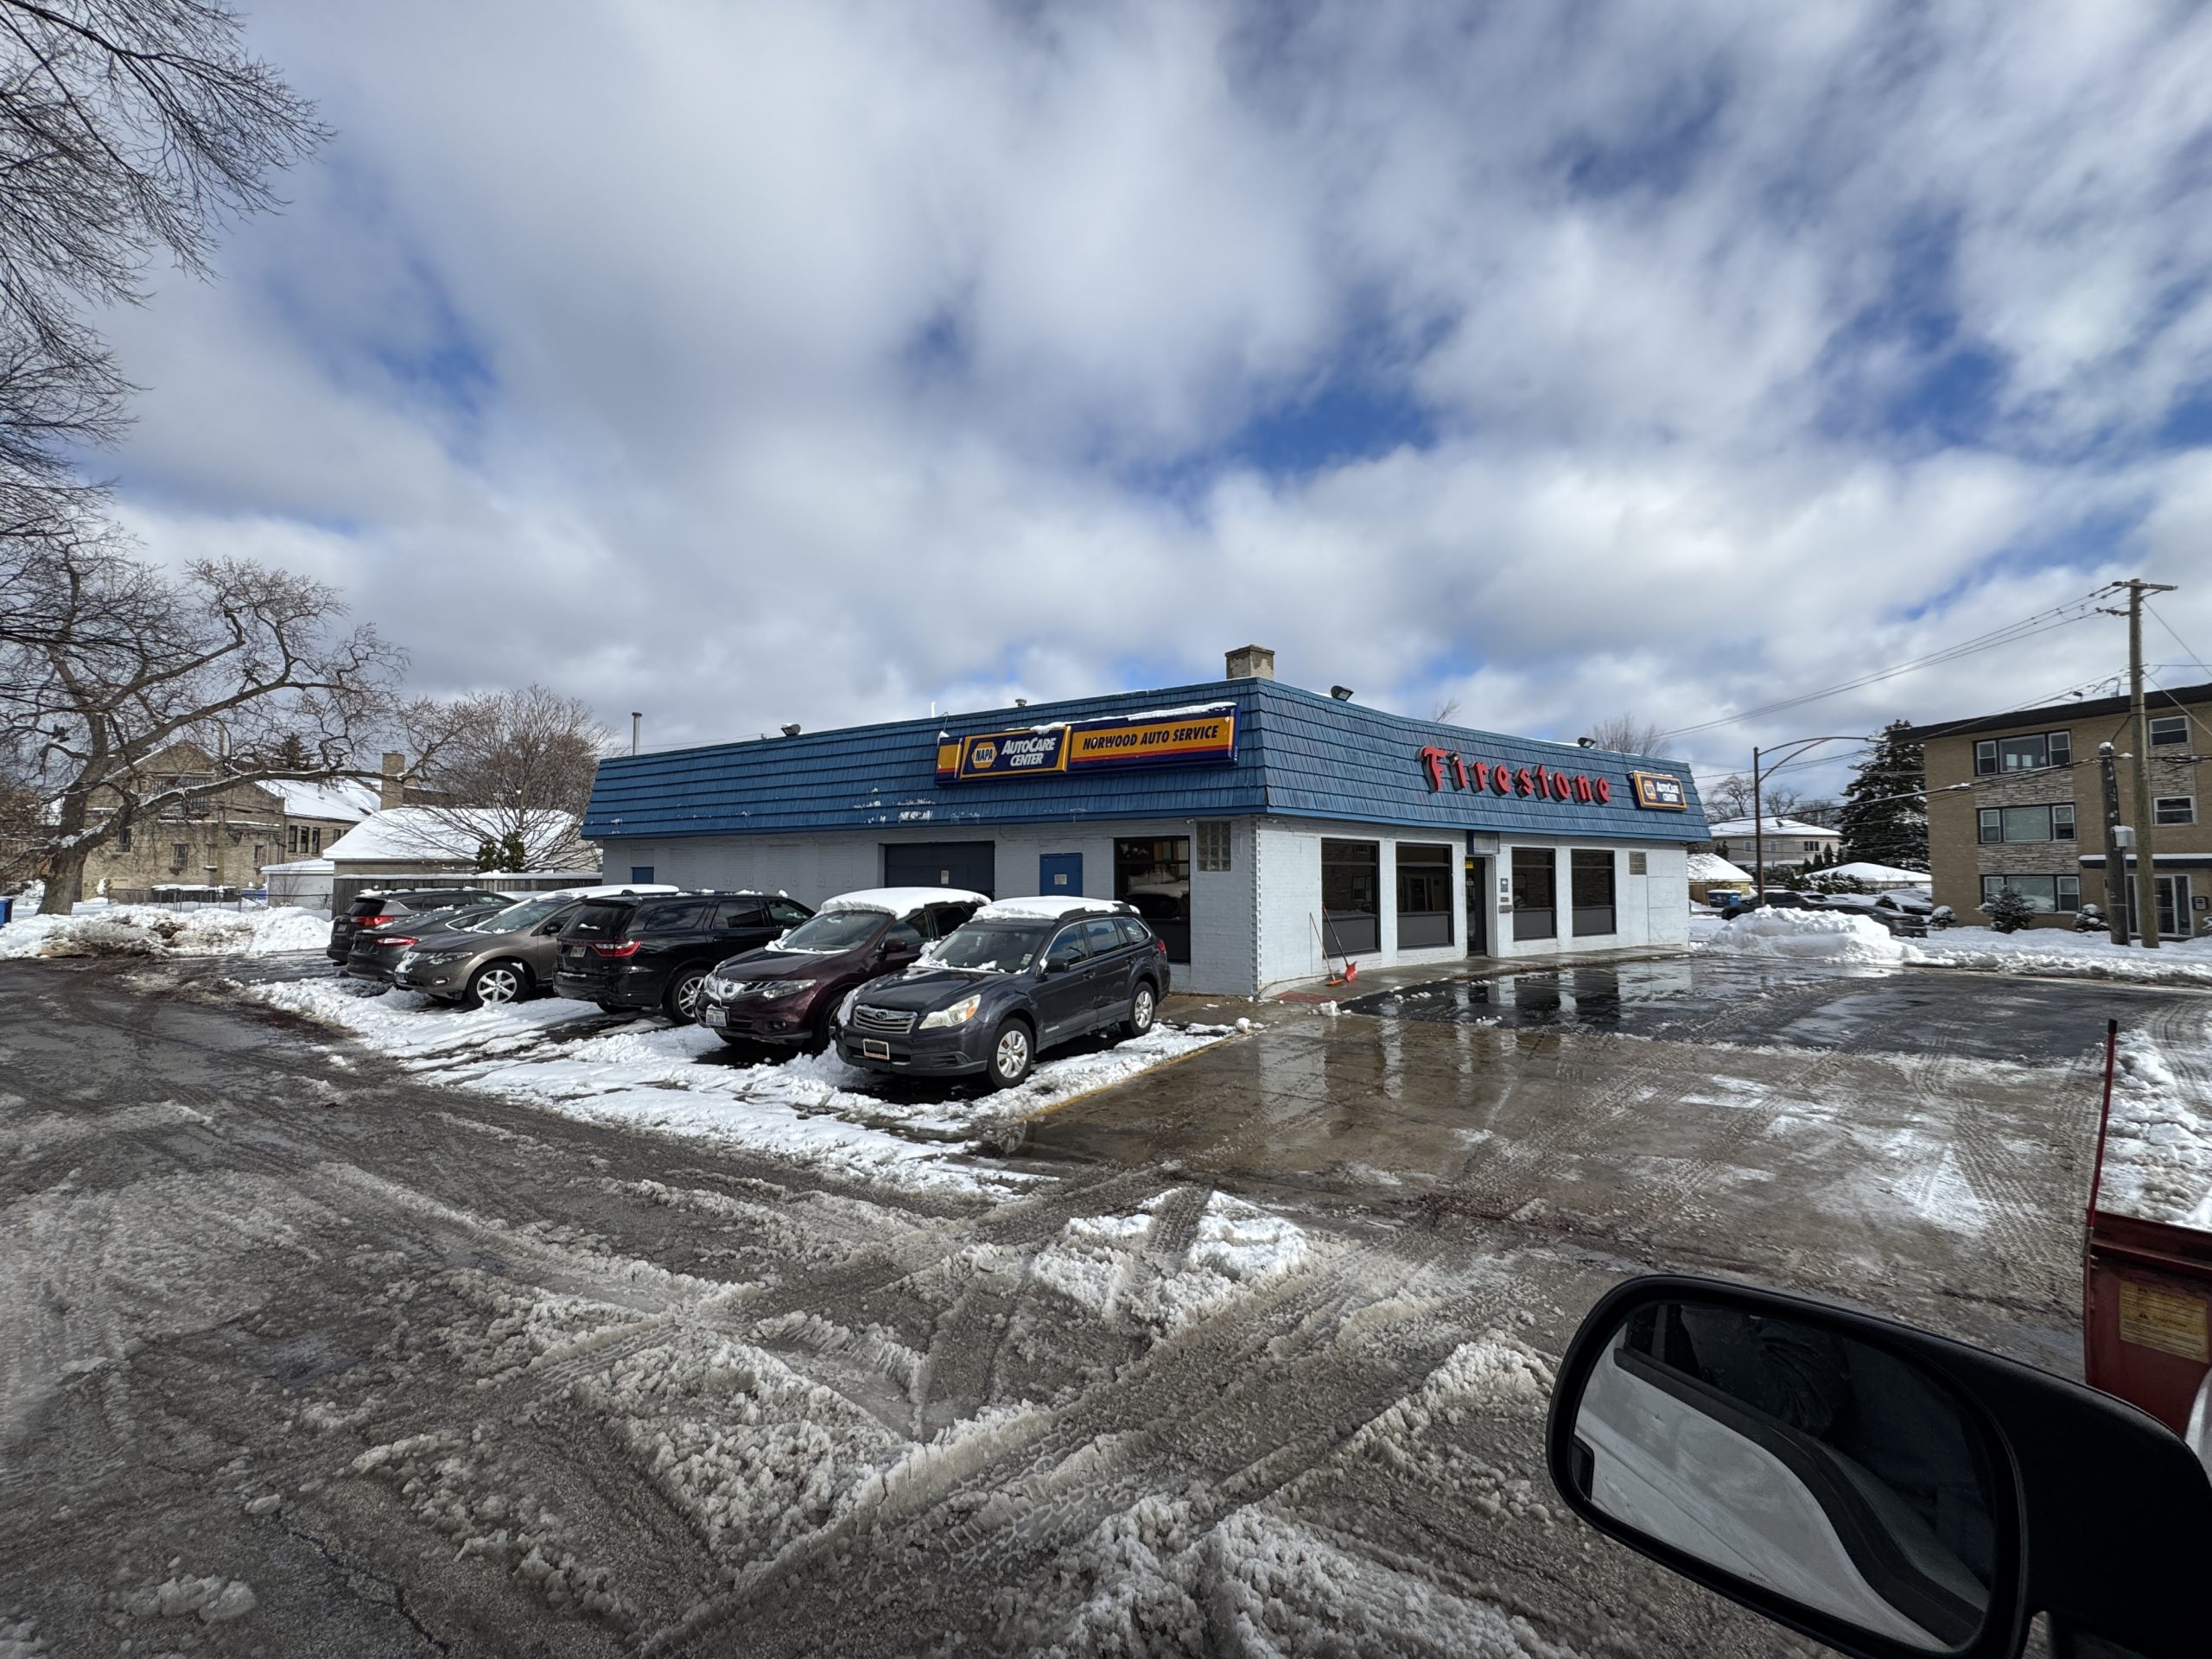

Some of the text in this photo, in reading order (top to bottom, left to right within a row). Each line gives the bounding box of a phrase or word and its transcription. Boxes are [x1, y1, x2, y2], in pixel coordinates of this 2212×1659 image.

[1083, 725, 1219, 750] NORWOOD AUTO SERVICE
[976, 748, 994, 762] NAPA
[1010, 753, 1044, 766] CENTER
[1416, 745, 1611, 804] Firestone
